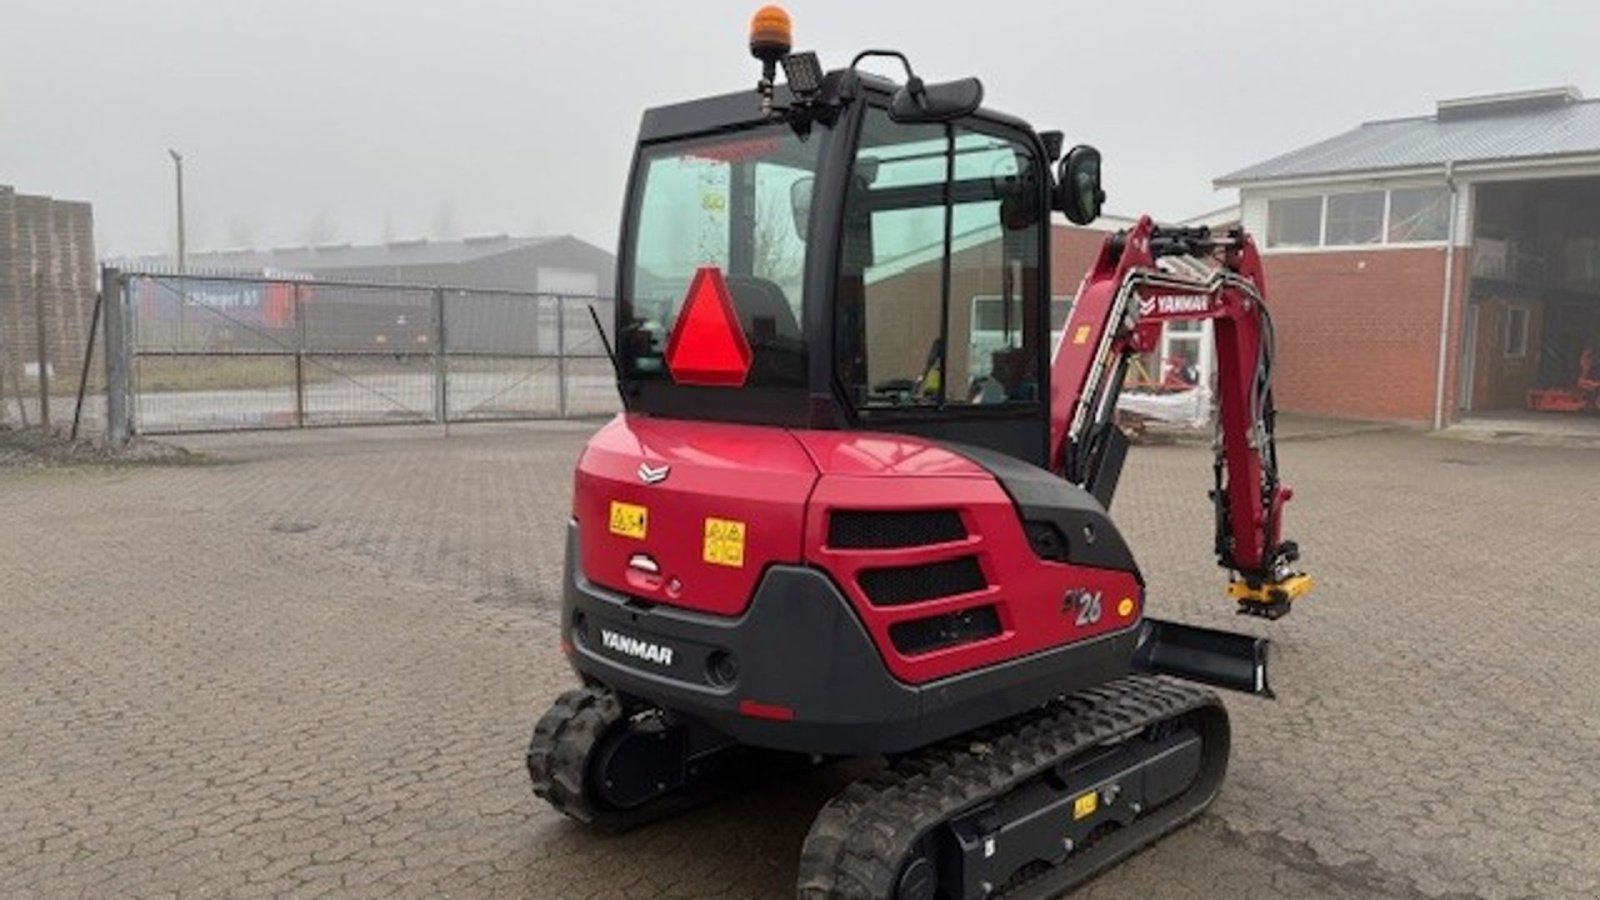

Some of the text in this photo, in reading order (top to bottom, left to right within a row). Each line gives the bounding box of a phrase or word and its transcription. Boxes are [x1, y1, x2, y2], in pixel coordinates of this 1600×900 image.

[1157, 294, 1210, 313] YANMAR
[1075, 590, 1102, 626] 26
[602, 629, 674, 666] YANMAR
